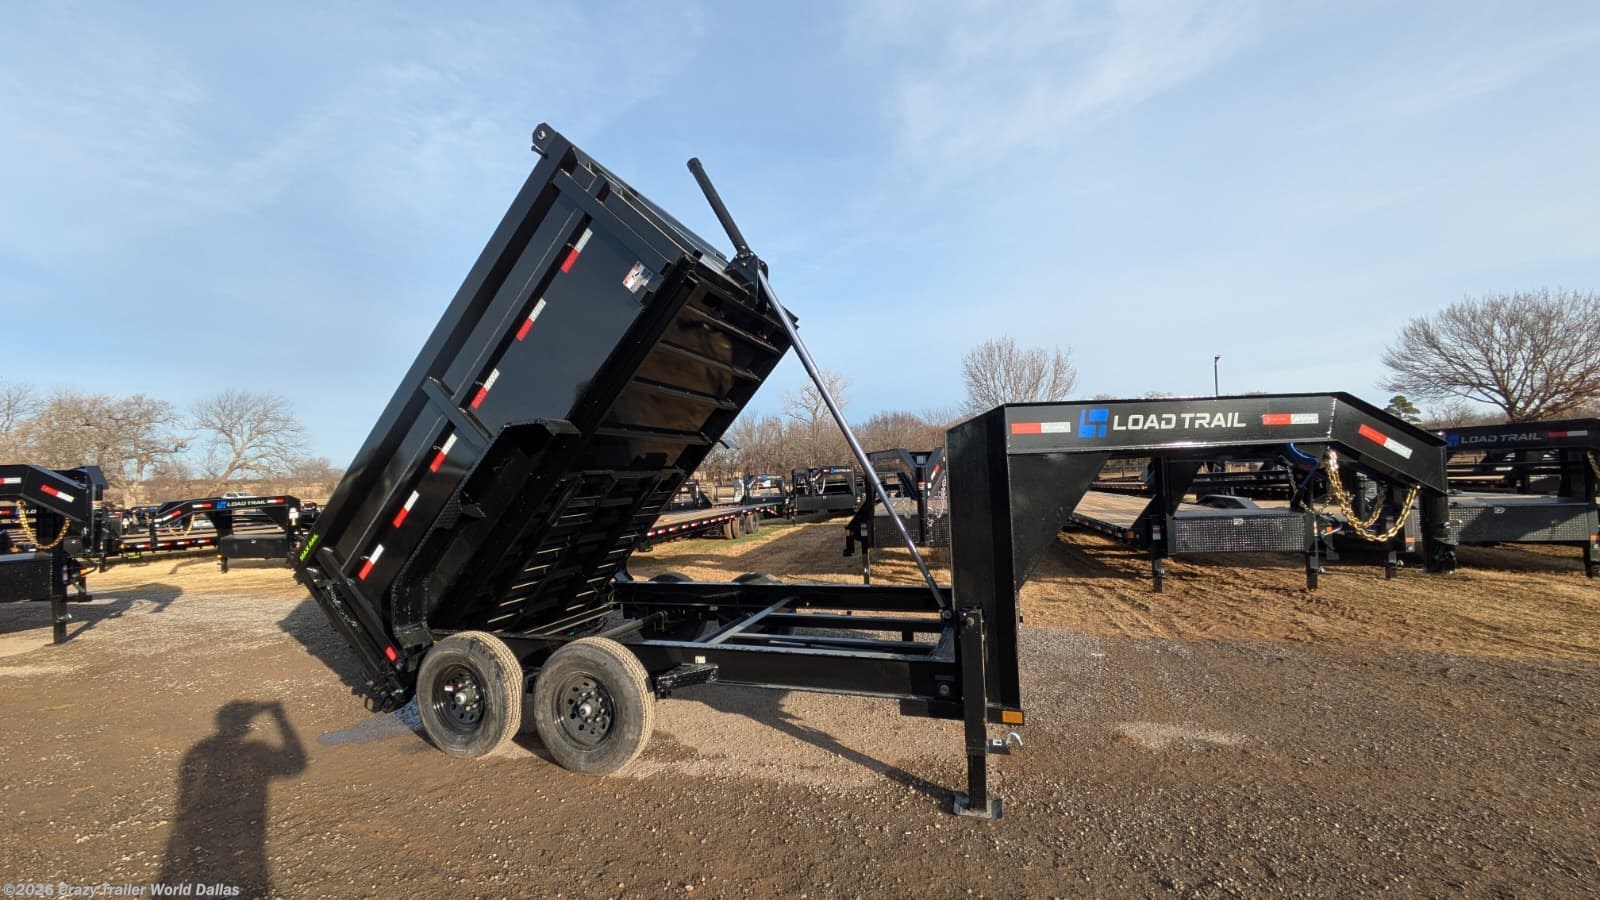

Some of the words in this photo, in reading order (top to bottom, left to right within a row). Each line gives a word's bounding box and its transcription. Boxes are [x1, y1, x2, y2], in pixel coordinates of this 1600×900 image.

[1112, 413, 1177, 431] LOAD
[1180, 412, 1247, 429] TRAIL
[1460, 435, 1498, 444] LOAD
[1499, 432, 1542, 442] TRAIL
